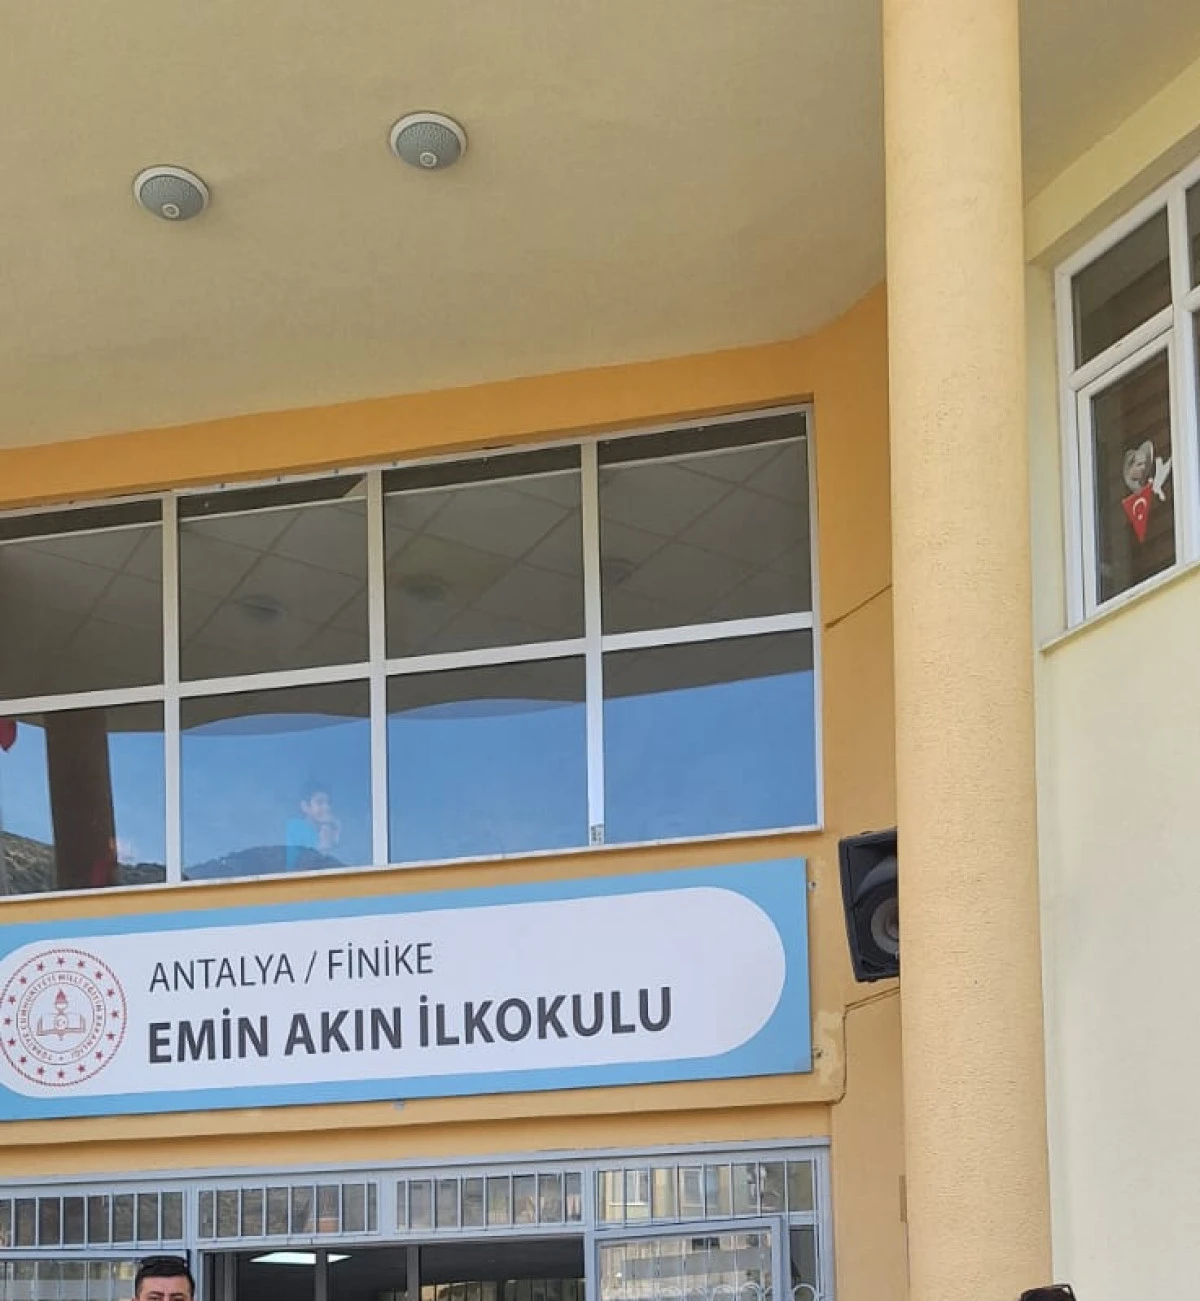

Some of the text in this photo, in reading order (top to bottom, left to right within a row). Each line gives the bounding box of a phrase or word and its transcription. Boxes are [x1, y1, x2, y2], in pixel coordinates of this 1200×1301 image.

[149, 939, 433, 992] ANTALYA / FİNİKE
[149, 987, 671, 1064] EMİN AKIN İLKOKULU
